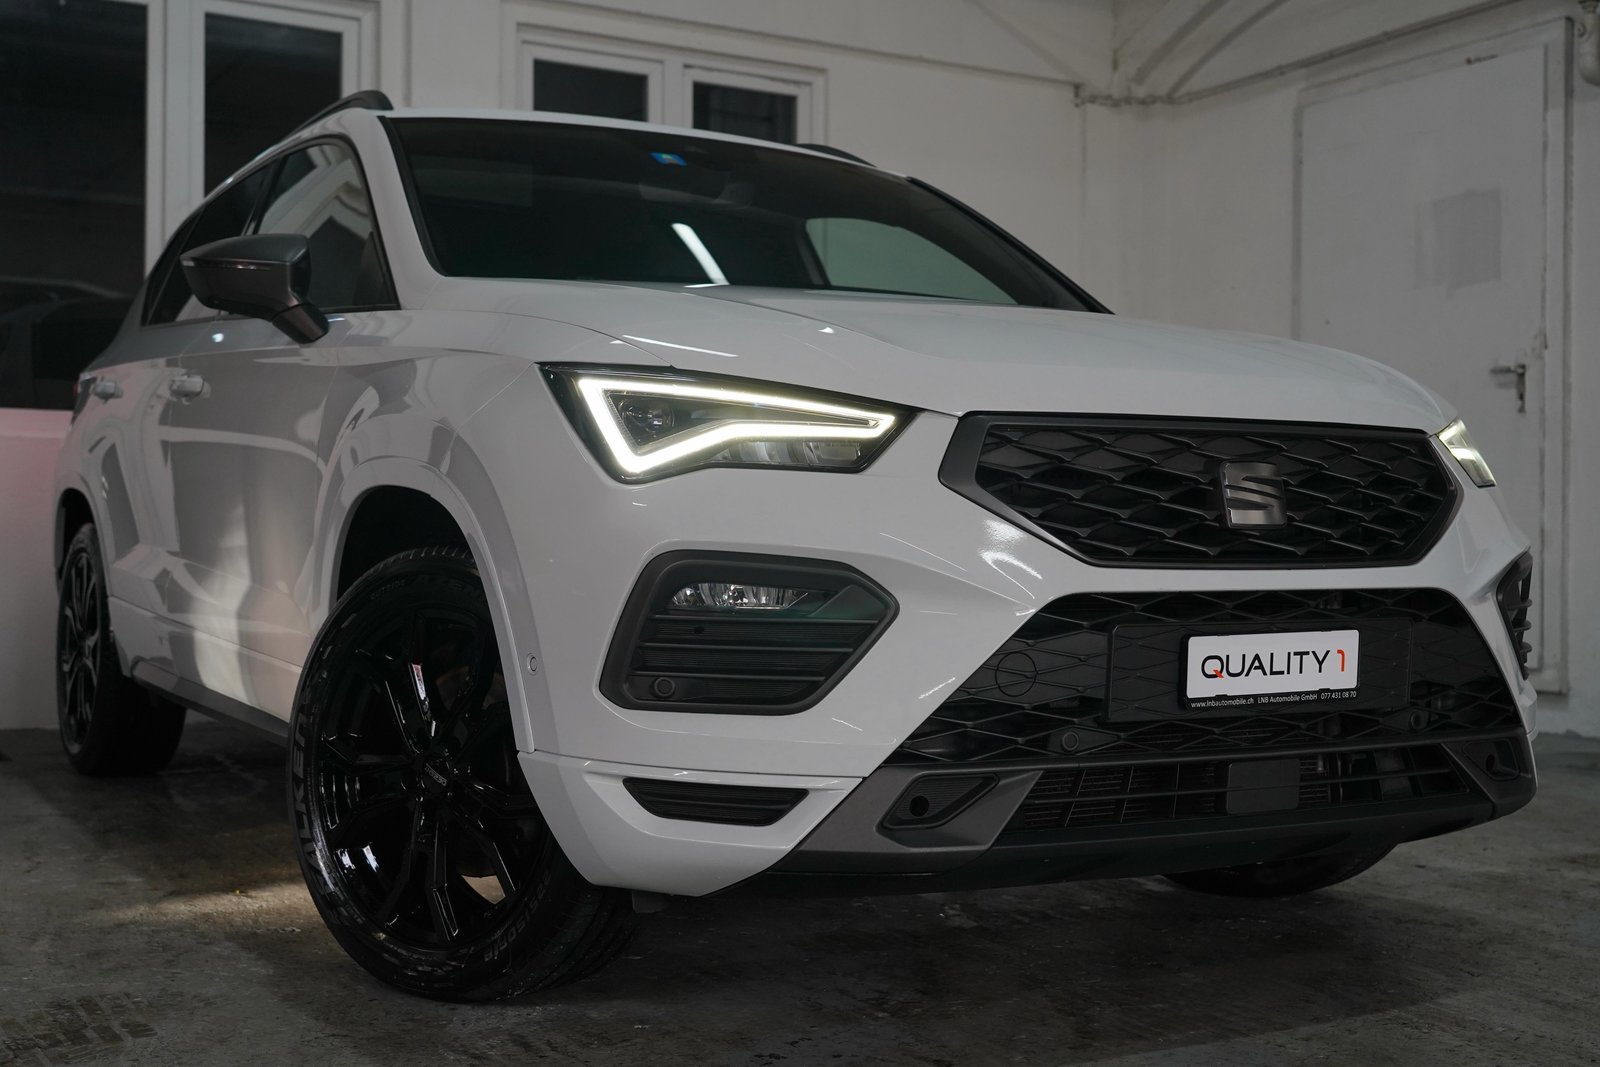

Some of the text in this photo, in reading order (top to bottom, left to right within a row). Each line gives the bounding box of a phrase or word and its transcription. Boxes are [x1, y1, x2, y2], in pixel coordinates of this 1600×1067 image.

[1201, 649, 1346, 679] QUALITY 1
[1190, 697, 1255, 708] www.lnbautomobile.ch
[1257, 695, 1269, 704] LNB
[1269, 694, 1301, 703] Automobile
[1300, 693, 1318, 701] GmbH
[1320, 692, 1331, 700] 077
[1331, 691, 1341, 699] 431
[1349, 690, 1357, 698] 70
